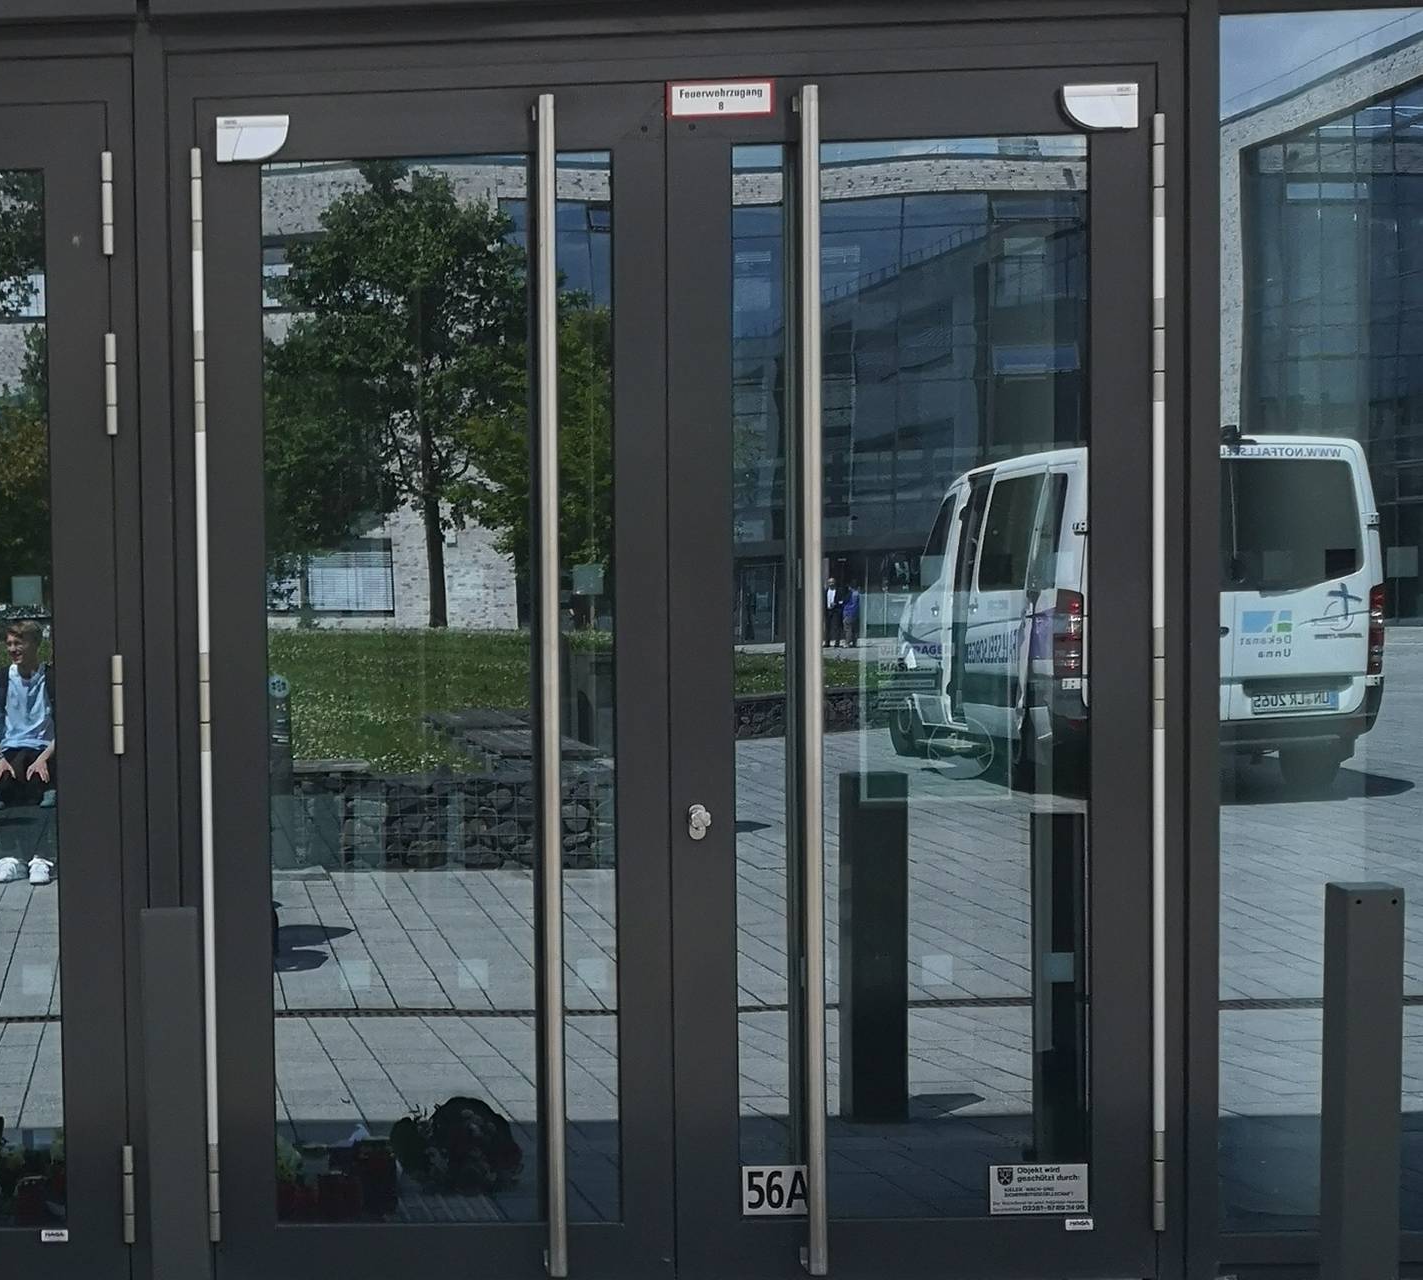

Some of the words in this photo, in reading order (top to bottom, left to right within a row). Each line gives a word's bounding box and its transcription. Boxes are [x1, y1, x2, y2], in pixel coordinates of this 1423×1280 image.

[679, 88, 763, 99] Feuerwehrzugang
[1017, 1167, 1043, 1175] Objekt
[1017, 1174, 1055, 1183] geschützt
[747, 1171, 808, 1209] 56A
